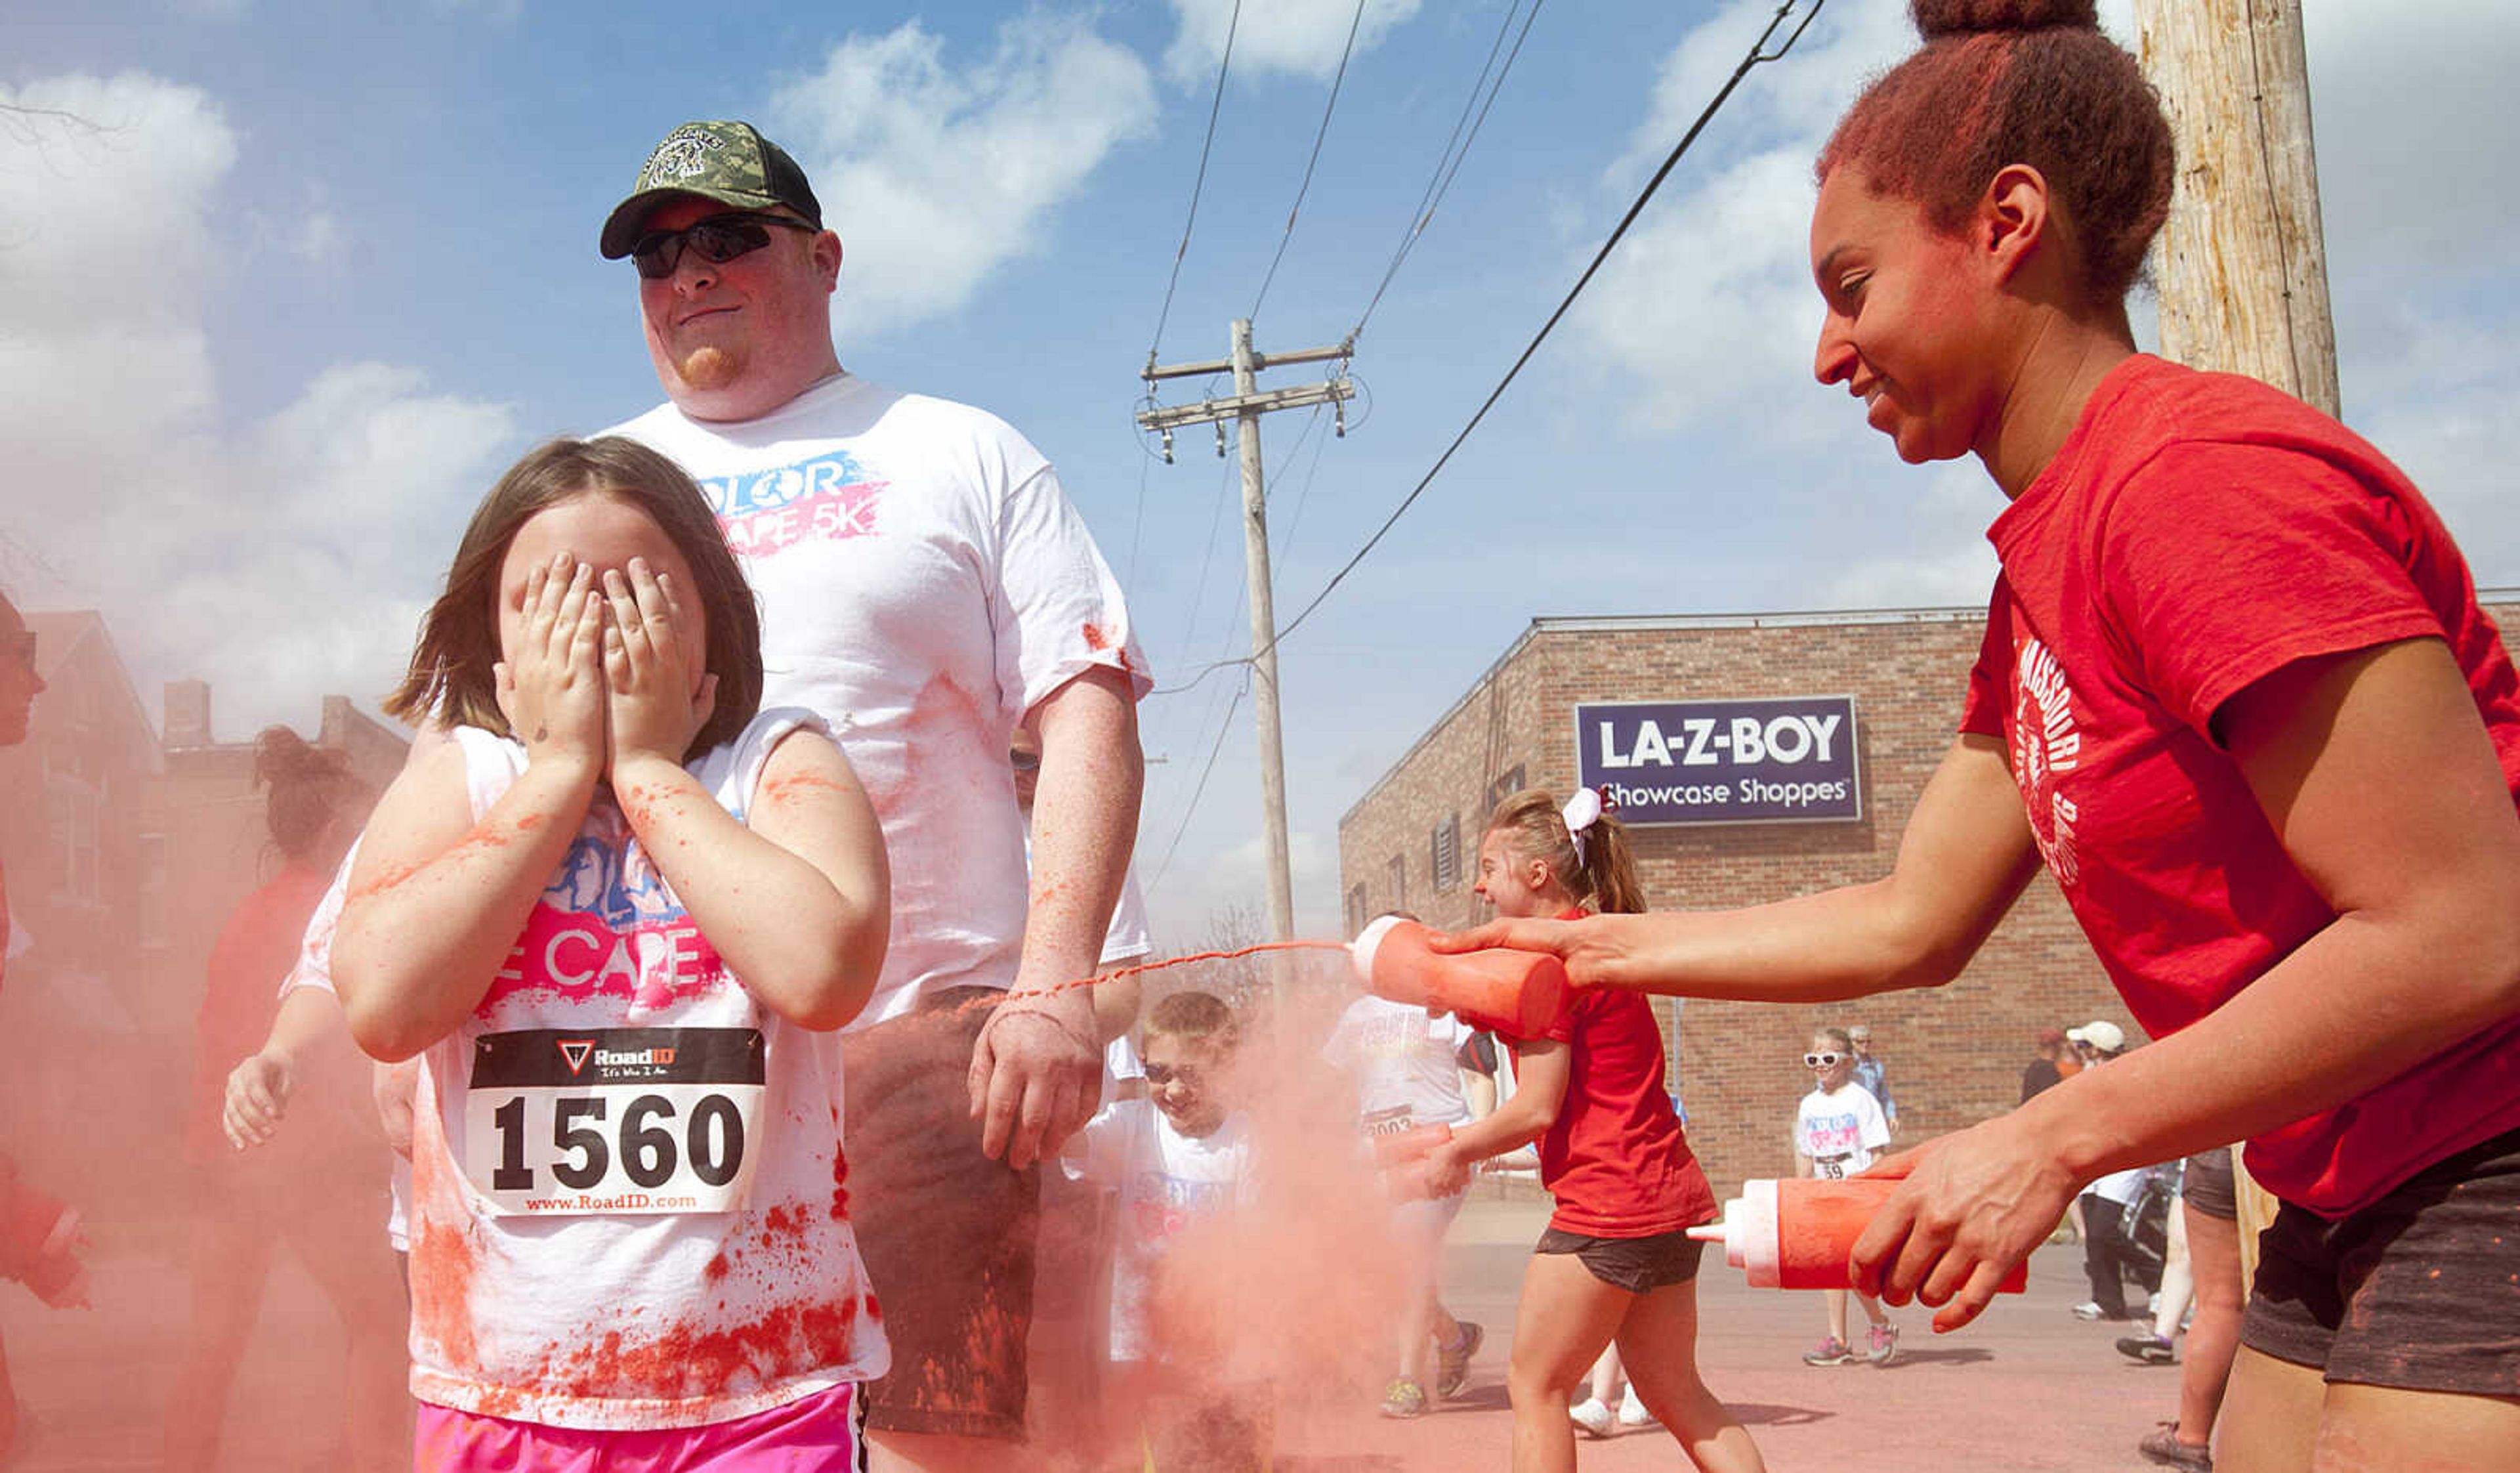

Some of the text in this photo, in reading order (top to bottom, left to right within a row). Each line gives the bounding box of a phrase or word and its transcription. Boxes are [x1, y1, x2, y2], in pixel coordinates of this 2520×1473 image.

[700, 460, 845, 515] OLOR
[728, 499, 868, 547] APE 5K
[1599, 715, 1841, 768] LA-Z-BOY
[1601, 779, 1845, 807] Showcase Shoppes
[545, 928, 698, 989] CAPE
[595, 1048, 675, 1065] RoadID
[493, 1094, 744, 1190] 1560
[526, 1193, 697, 1211] www.RoadID.com
